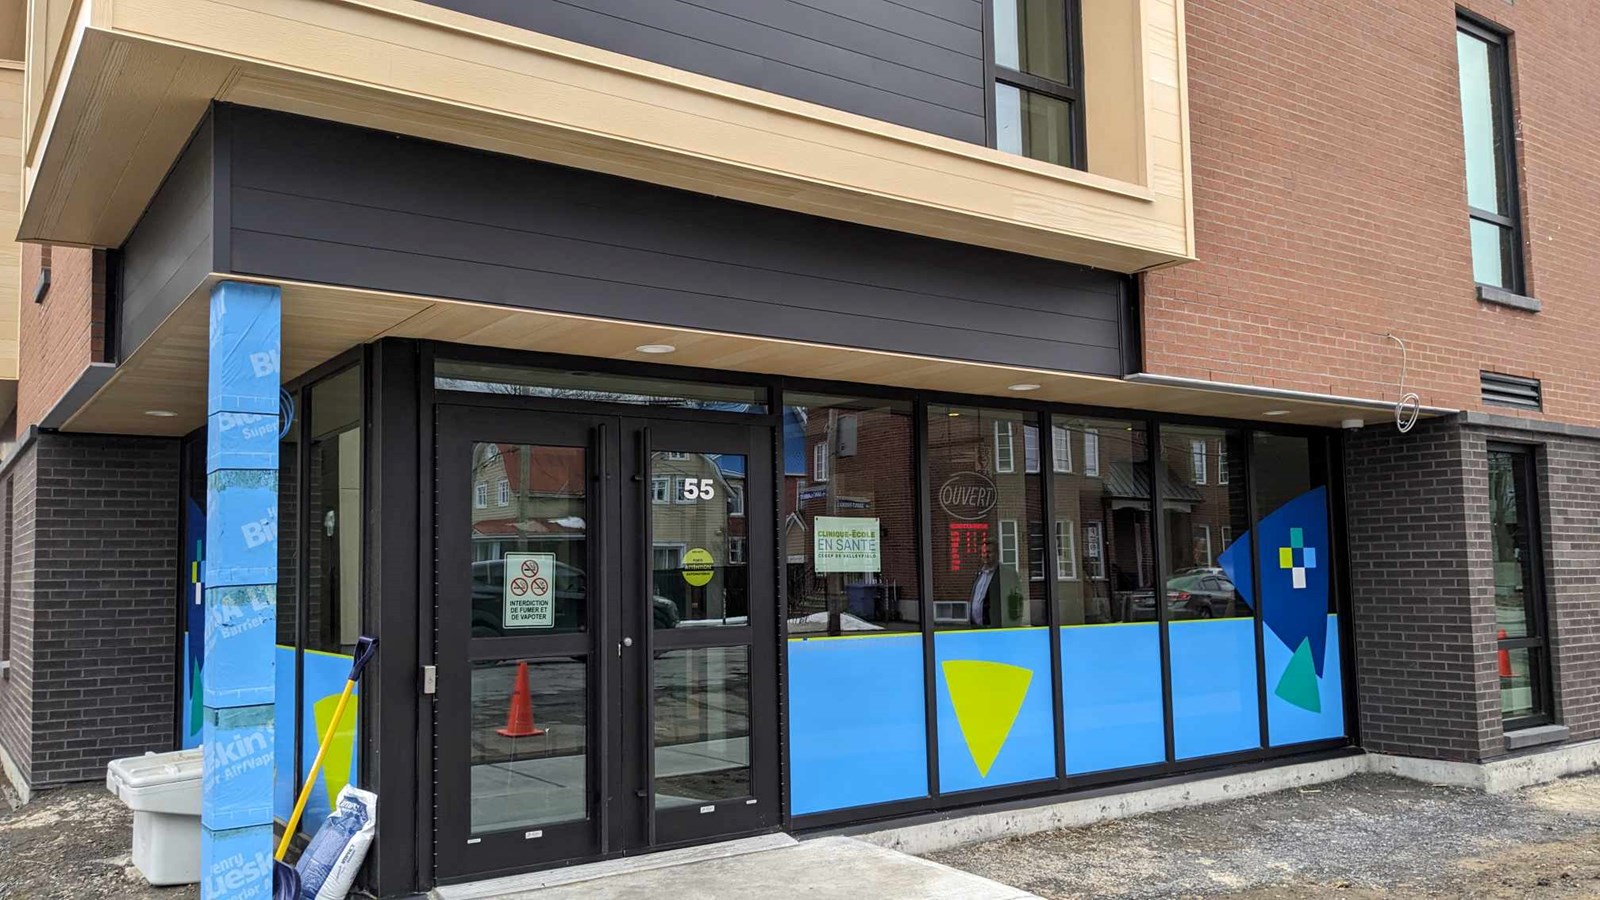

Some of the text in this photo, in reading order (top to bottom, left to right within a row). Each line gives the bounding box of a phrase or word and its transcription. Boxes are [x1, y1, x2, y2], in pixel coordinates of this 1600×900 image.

[683, 478, 715, 500] 55
[942, 485, 993, 507] OUVERT
[818, 538, 833, 550] EN
